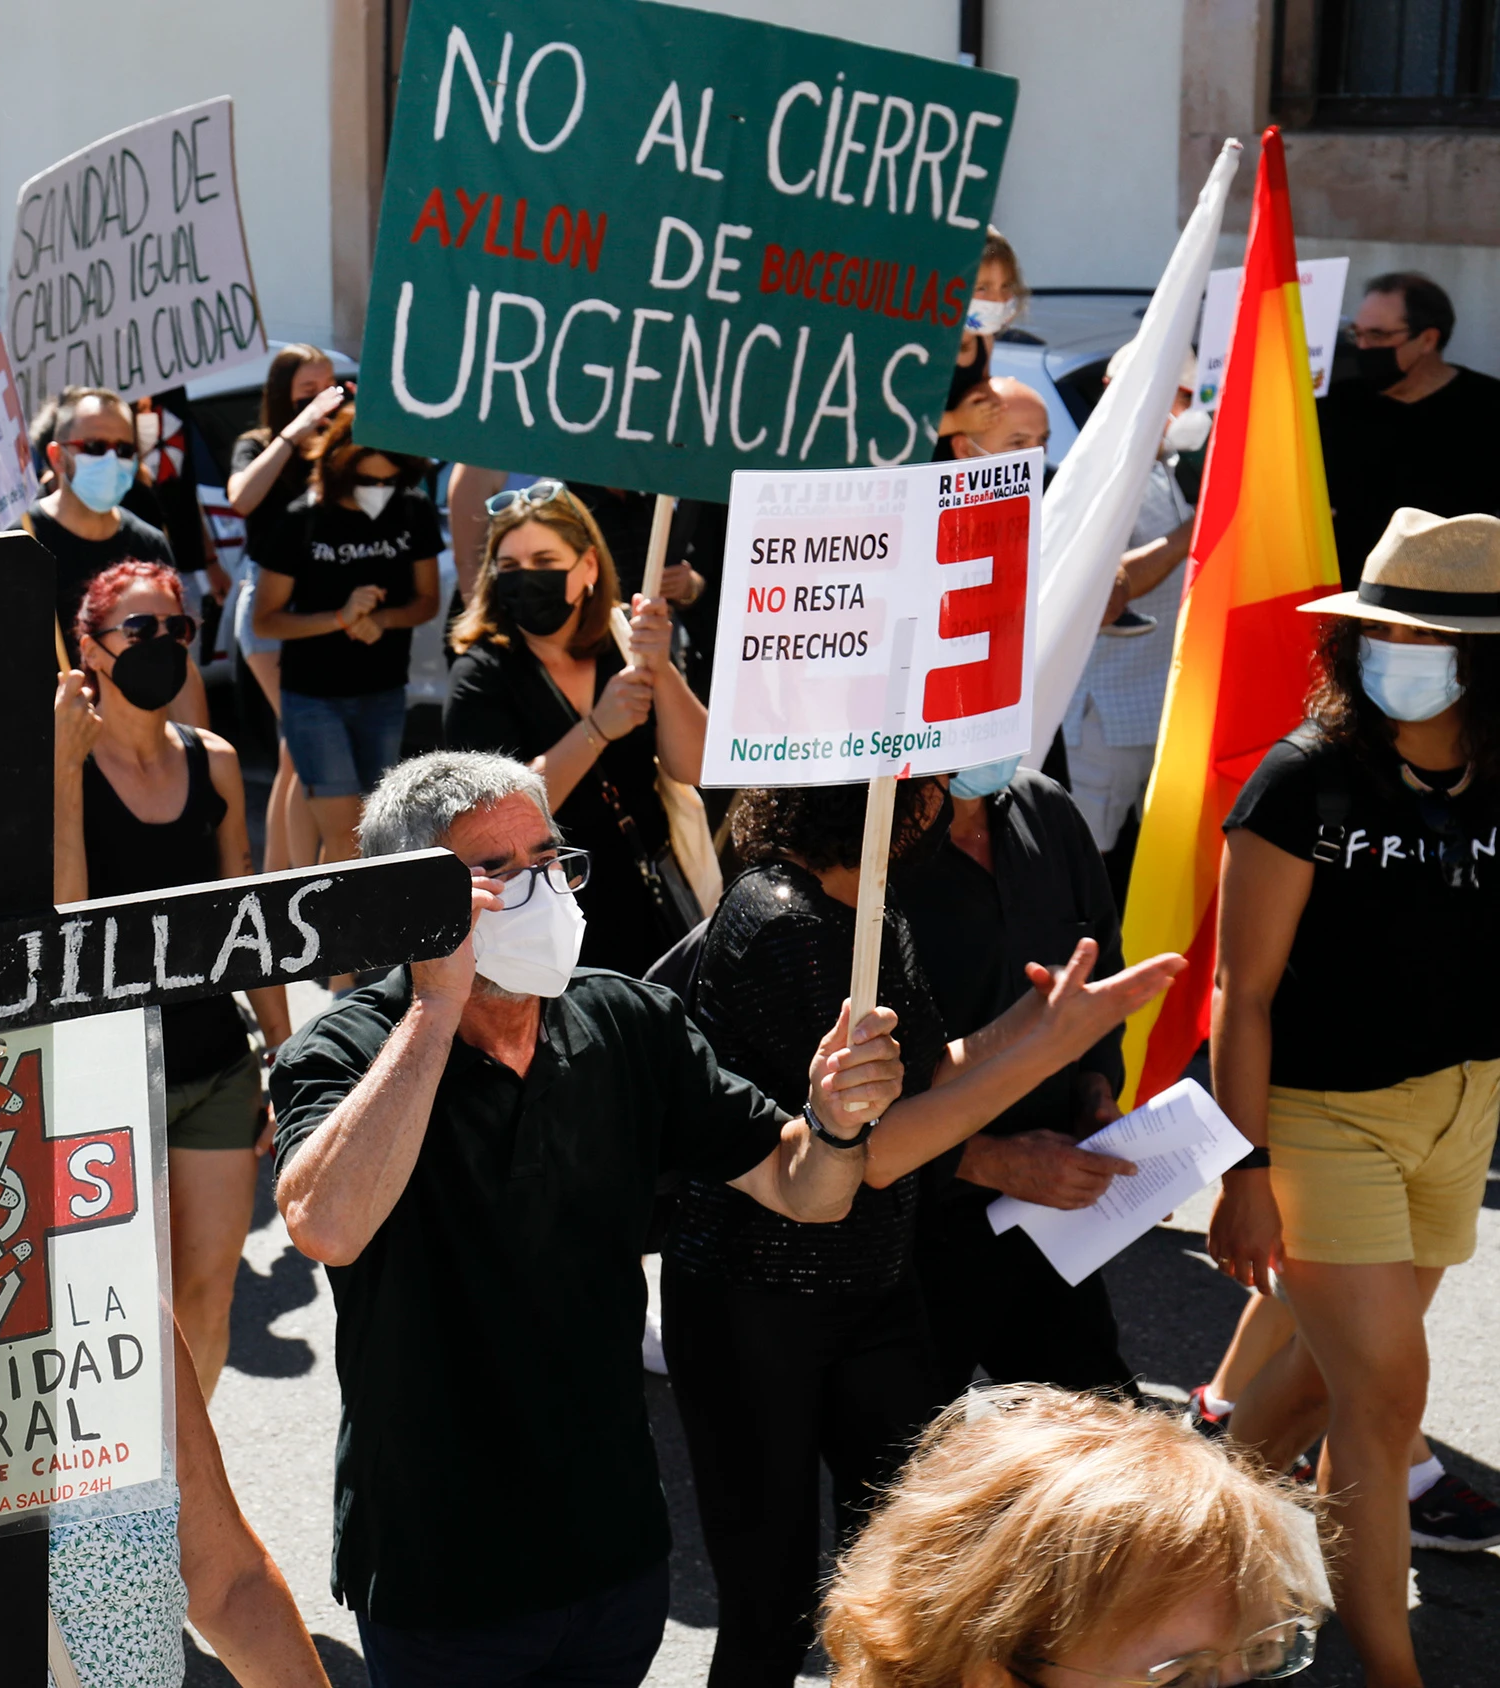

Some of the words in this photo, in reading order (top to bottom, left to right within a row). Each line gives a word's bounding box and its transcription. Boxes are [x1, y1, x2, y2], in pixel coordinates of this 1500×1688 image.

[434, 25, 586, 153] NO
[636, 80, 723, 181] AL
[172, 116, 220, 214] DE
[410, 187, 607, 273] AYLLON
[650, 216, 753, 302] DE
[759, 243, 967, 328] BOCEGUILLAS
[11, 259, 115, 362] CALIDAD
[130, 222, 211, 301] IGUAL
[114, 318, 145, 391] LA
[152, 282, 260, 379] CIUDAD
[392, 281, 930, 467] URGENCIAS
[940, 461, 1031, 495] REVUELTA
[938, 497, 950, 508] de
[953, 495, 961, 506] la
[750, 537, 796, 565] SER
[804, 533, 889, 563] MENOS
[747, 586, 786, 613] NO
[793, 583, 865, 612] RESTA
[742, 631, 869, 661] DERECHOS
[730, 736, 833, 762] Nordeste
[840, 732, 865, 756] de
[870, 725, 942, 761] Segovia
[67, 1280, 127, 1326] LA
[16, 1484, 73, 1507] SALUD
[79, 1476, 112, 1497] 24H
